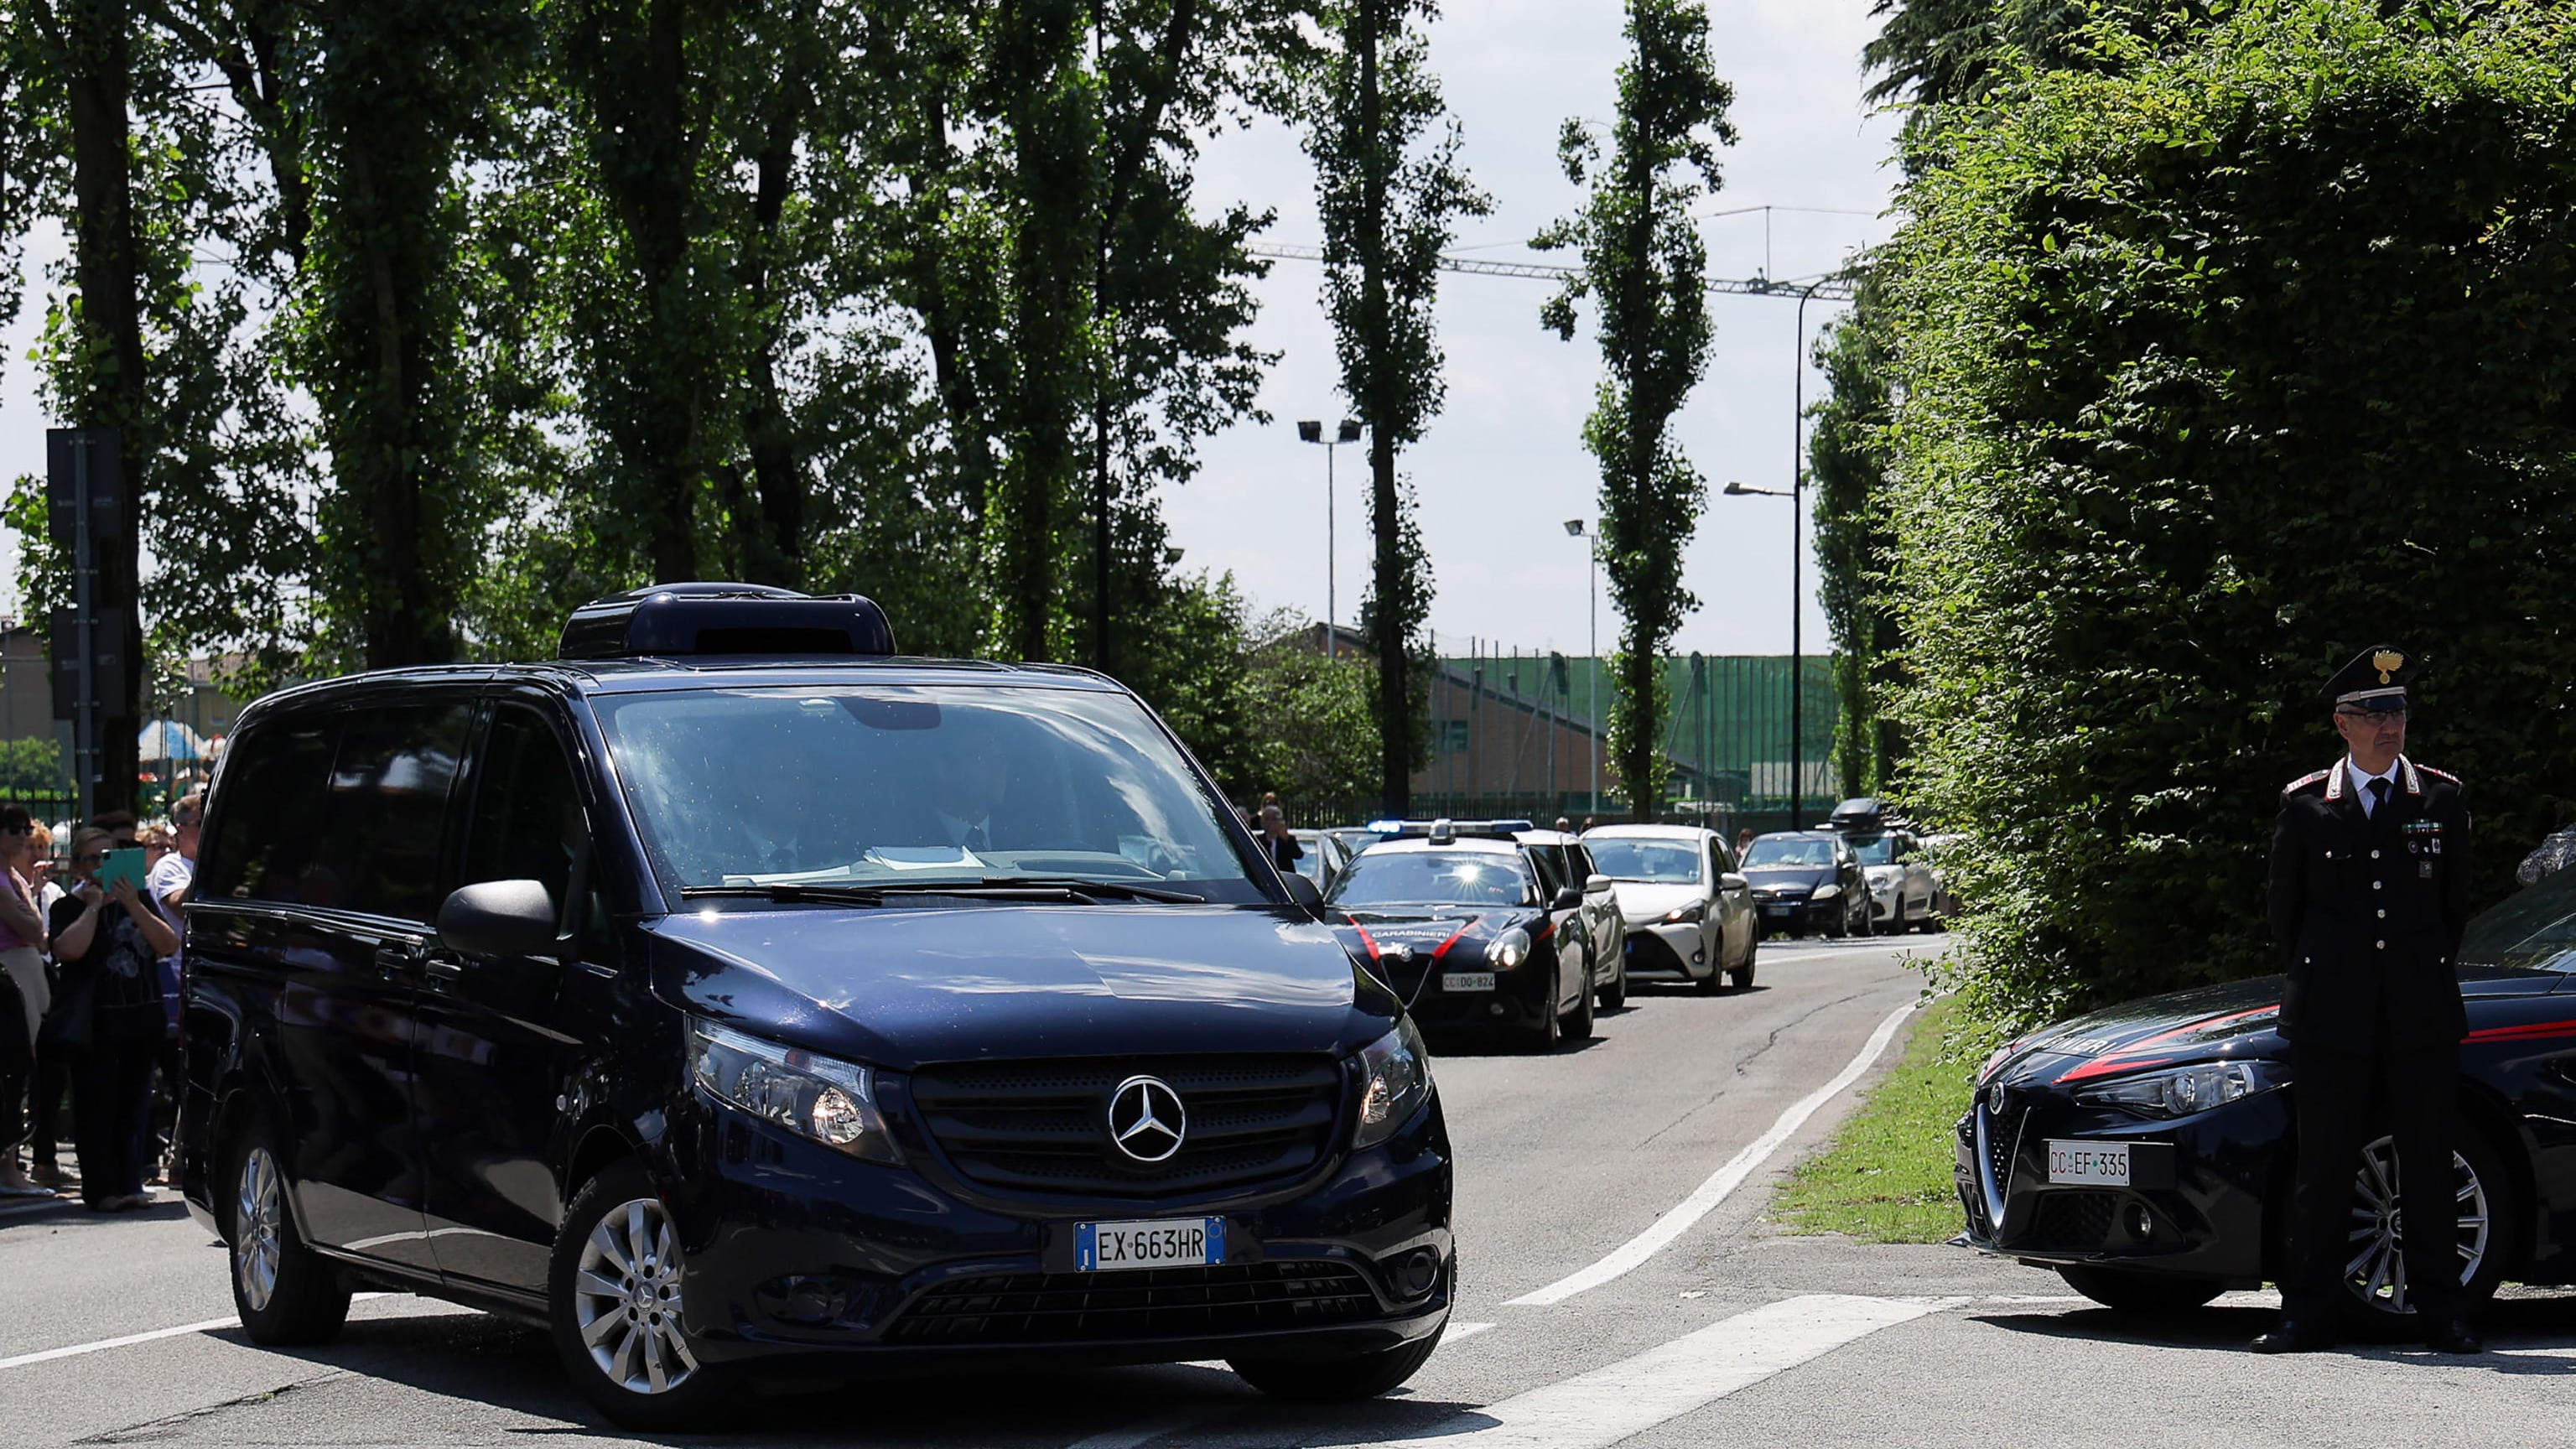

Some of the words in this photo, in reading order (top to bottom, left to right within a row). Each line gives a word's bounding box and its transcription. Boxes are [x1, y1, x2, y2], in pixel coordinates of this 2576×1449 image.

[1371, 930, 1450, 938] CARABINIERI
[2050, 1151, 2066, 1173] CC
[2075, 1152, 2091, 1174] EF
[2099, 1153, 2127, 1176] 335
